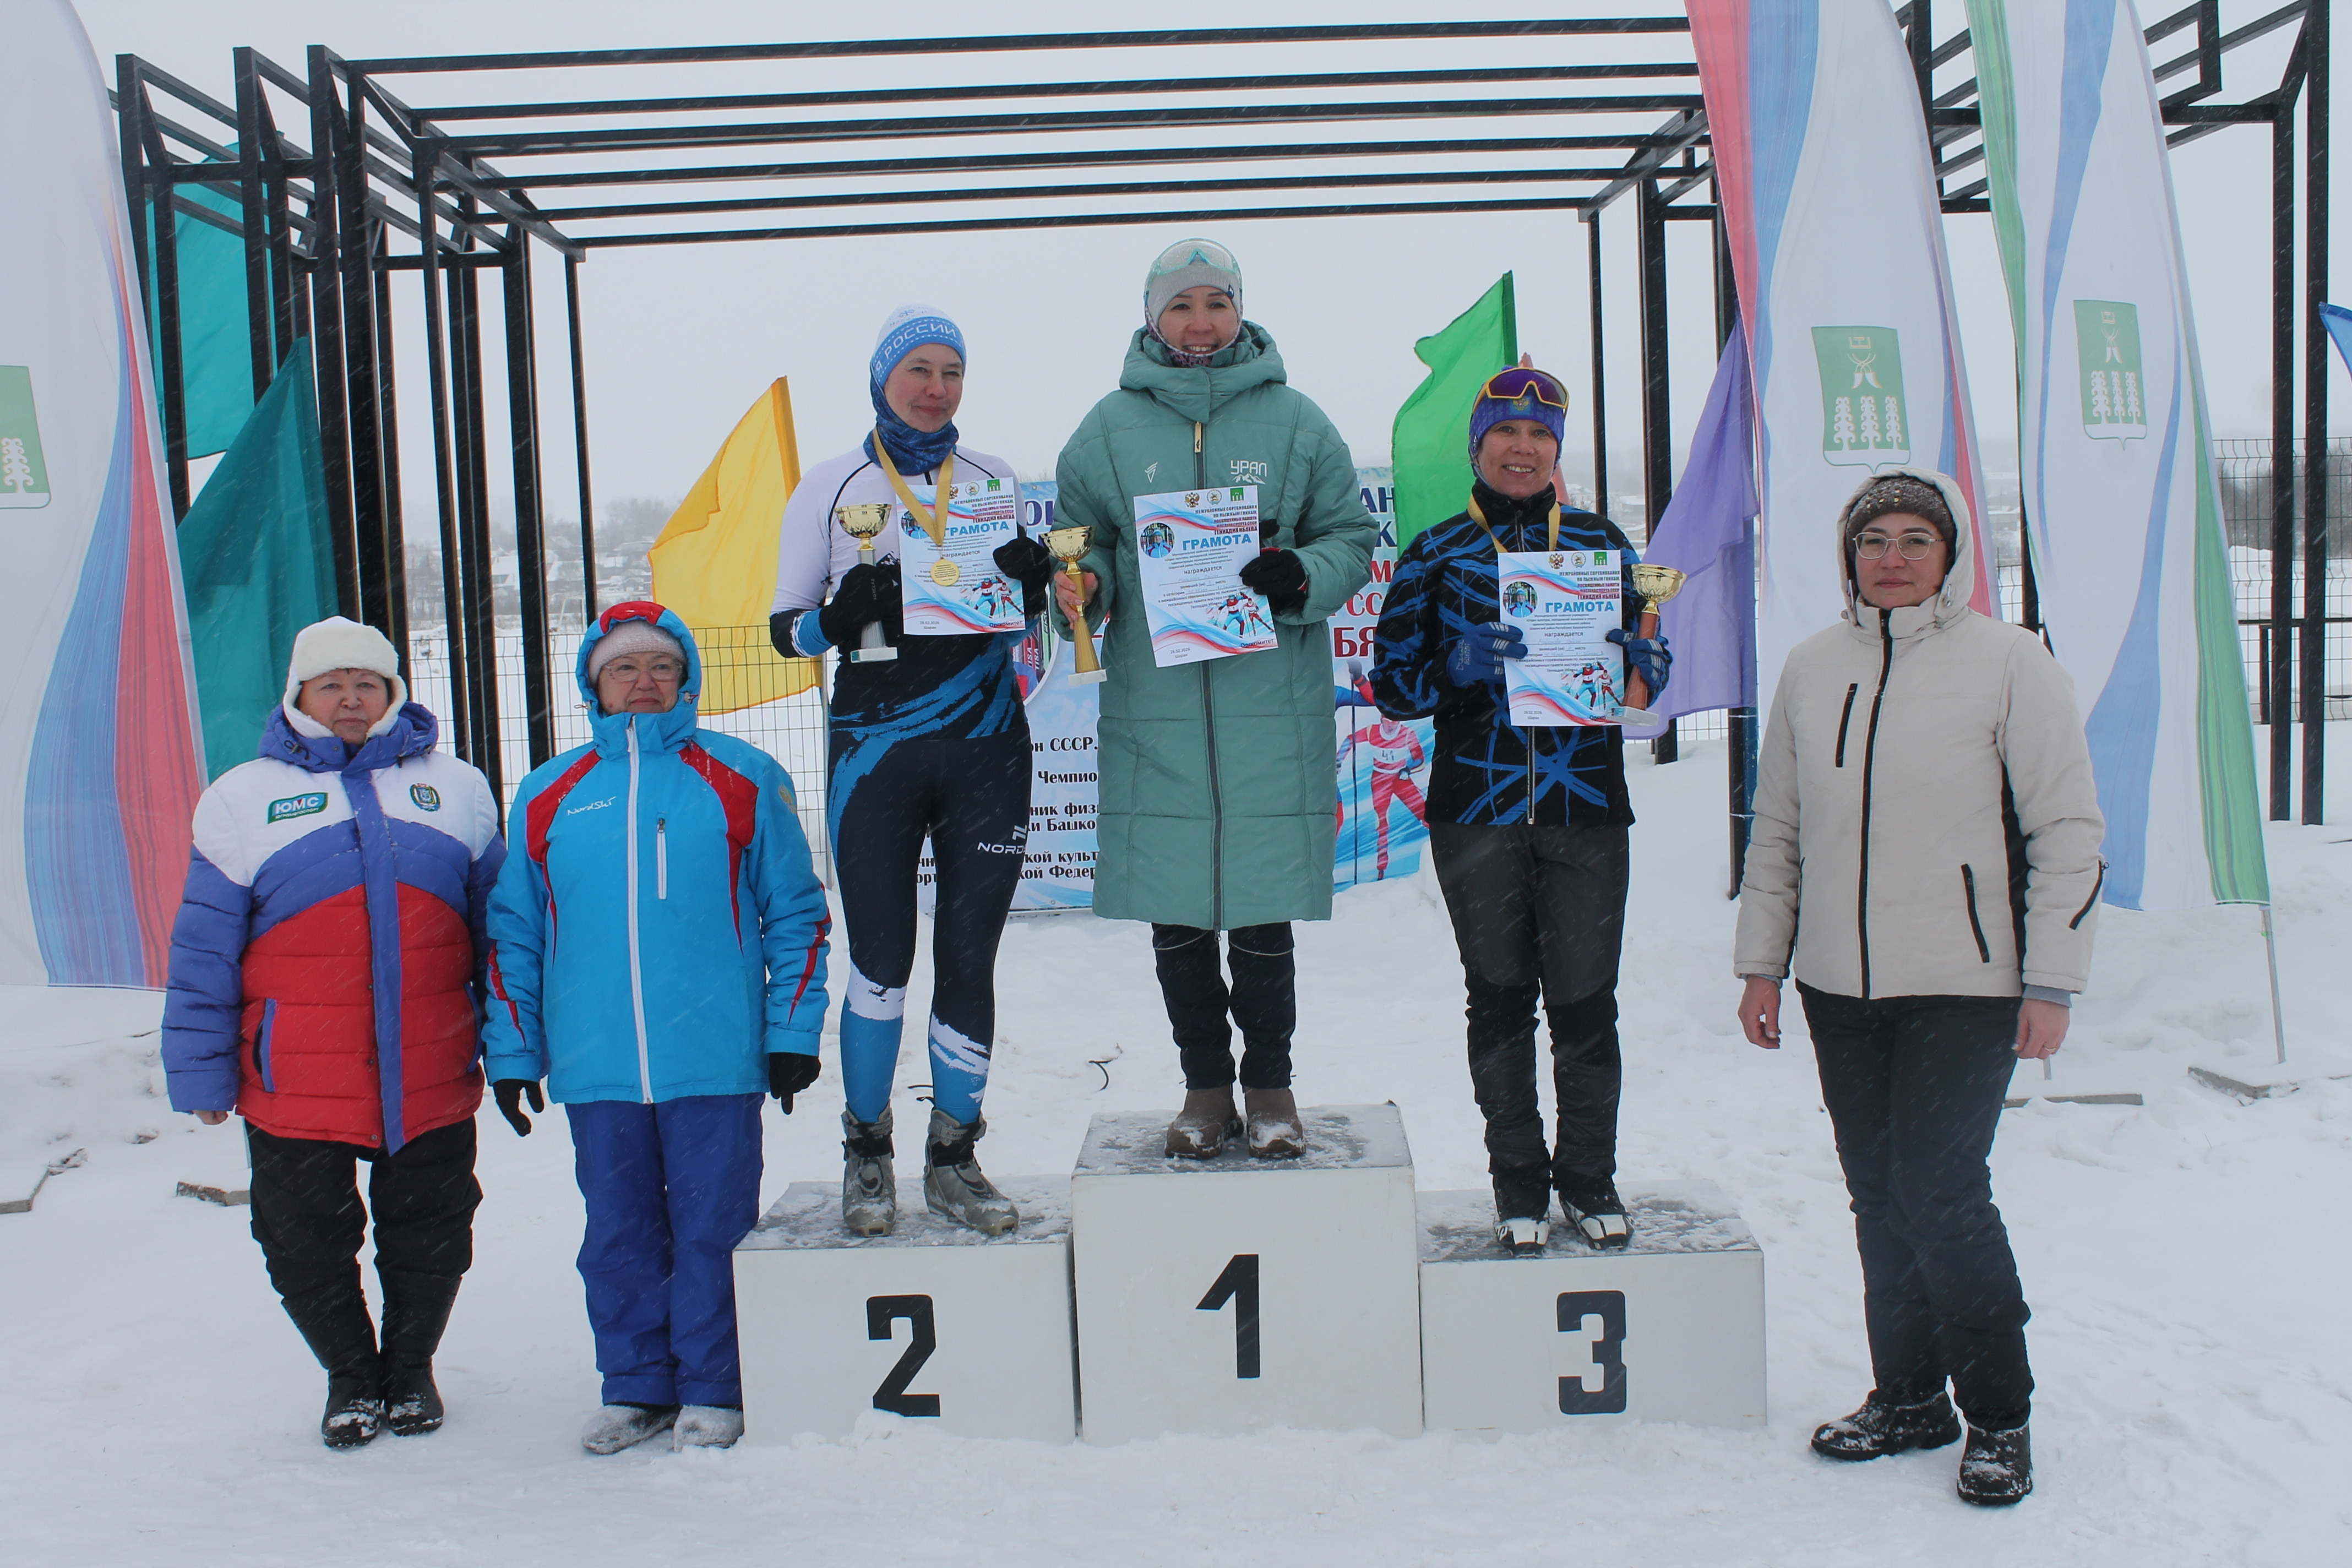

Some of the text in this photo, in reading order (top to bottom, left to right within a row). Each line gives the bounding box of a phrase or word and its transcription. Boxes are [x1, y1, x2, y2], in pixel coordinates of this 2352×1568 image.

[884, 323, 956, 359] РОССИИ
[1231, 460, 1267, 477] УРАЛ
[1183, 534, 1251, 550] ГРАМОТА
[1184, 566, 1222, 574] награждается
[1545, 602, 1614, 612] ГРАМОТА
[1240, 639, 1274, 648] Оргкомитет
[1050, 737, 1098, 751] СССР.
[1382, 750, 1394, 761] 41
[275, 797, 319, 814] ЮМС
[1064, 802, 1099, 817] физ
[1047, 818, 1096, 831] Башко
[1196, 1254, 1260, 1379] 1
[866, 1294, 940, 1417] 2
[1556, 1289, 1627, 1415] 3
